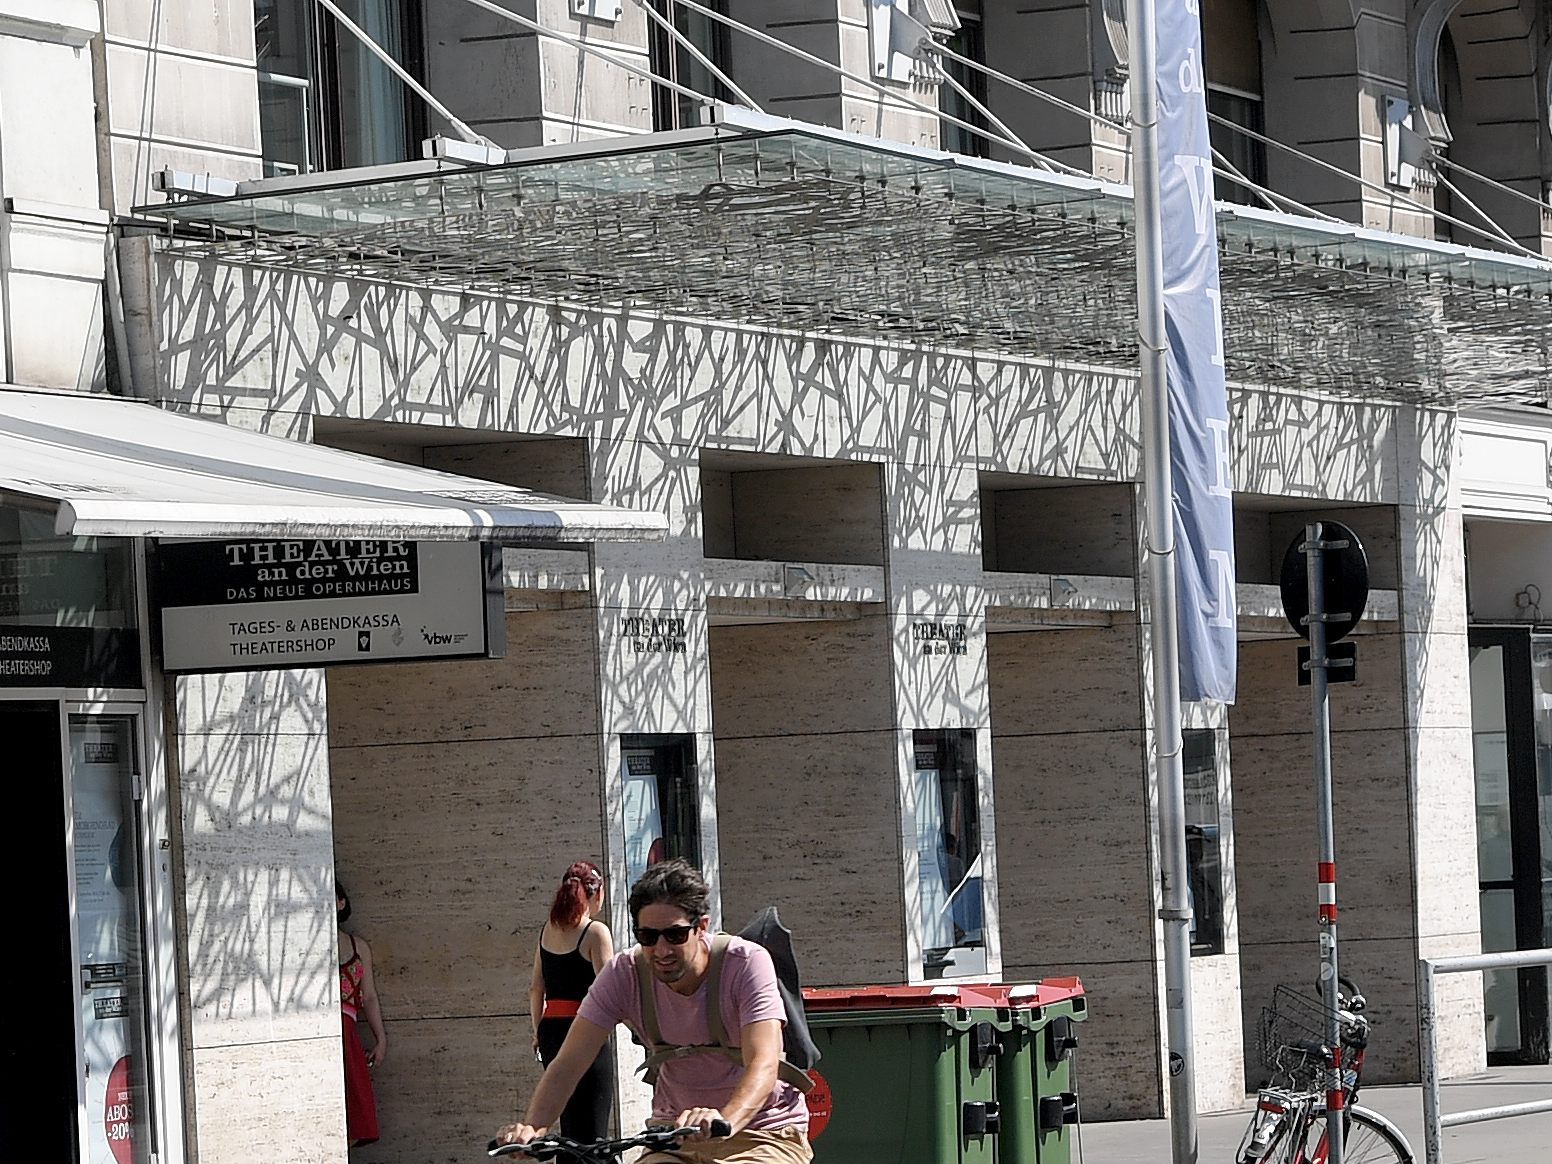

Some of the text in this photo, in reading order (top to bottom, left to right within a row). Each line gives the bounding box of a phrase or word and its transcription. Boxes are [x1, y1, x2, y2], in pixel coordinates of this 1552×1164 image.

[225, 539, 409, 566] THEATER
[257, 557, 411, 581] an der Wien
[227, 578, 411, 600] DAS NEUE OPERNHAUS
[229, 613, 401, 636] TAGES- & ABENDKASSA
[0, 636, 51, 651] BENDKASSA
[230, 638, 336, 656] THEATERSHOP
[426, 632, 453, 646] vbw
